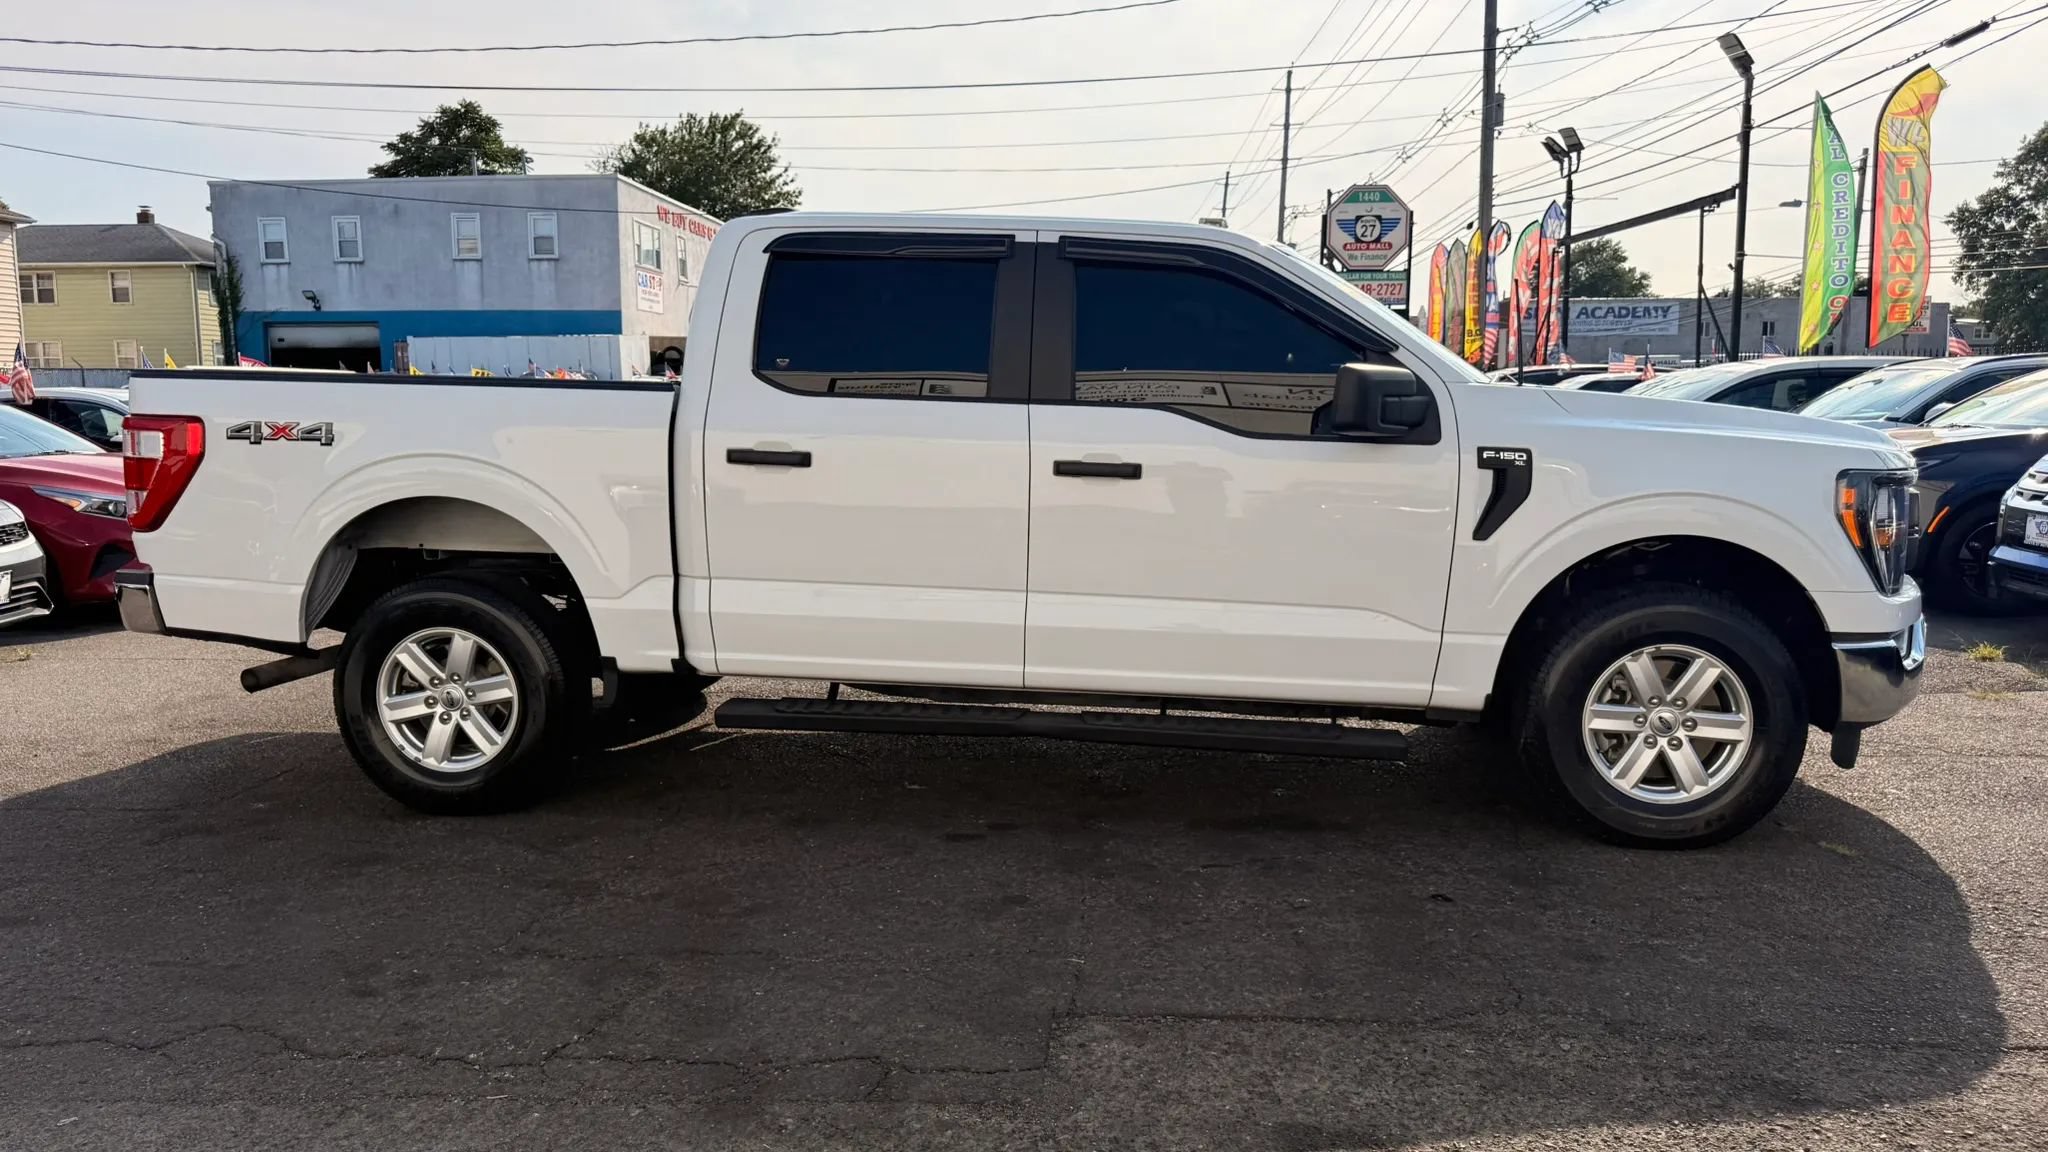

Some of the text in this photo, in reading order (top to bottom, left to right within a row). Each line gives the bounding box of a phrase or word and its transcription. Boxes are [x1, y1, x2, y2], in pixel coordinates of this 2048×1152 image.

[1359, 192, 1381, 202] 1440
[1360, 224, 1377, 238] 27
[1828, 172, 1850, 289] CREDITO
[1887, 156, 1917, 323] FINANCE
[1360, 252, 1388, 260] Finance
[1576, 306, 1672, 319] ACADEMY
[1483, 451, 1527, 460] F-150
